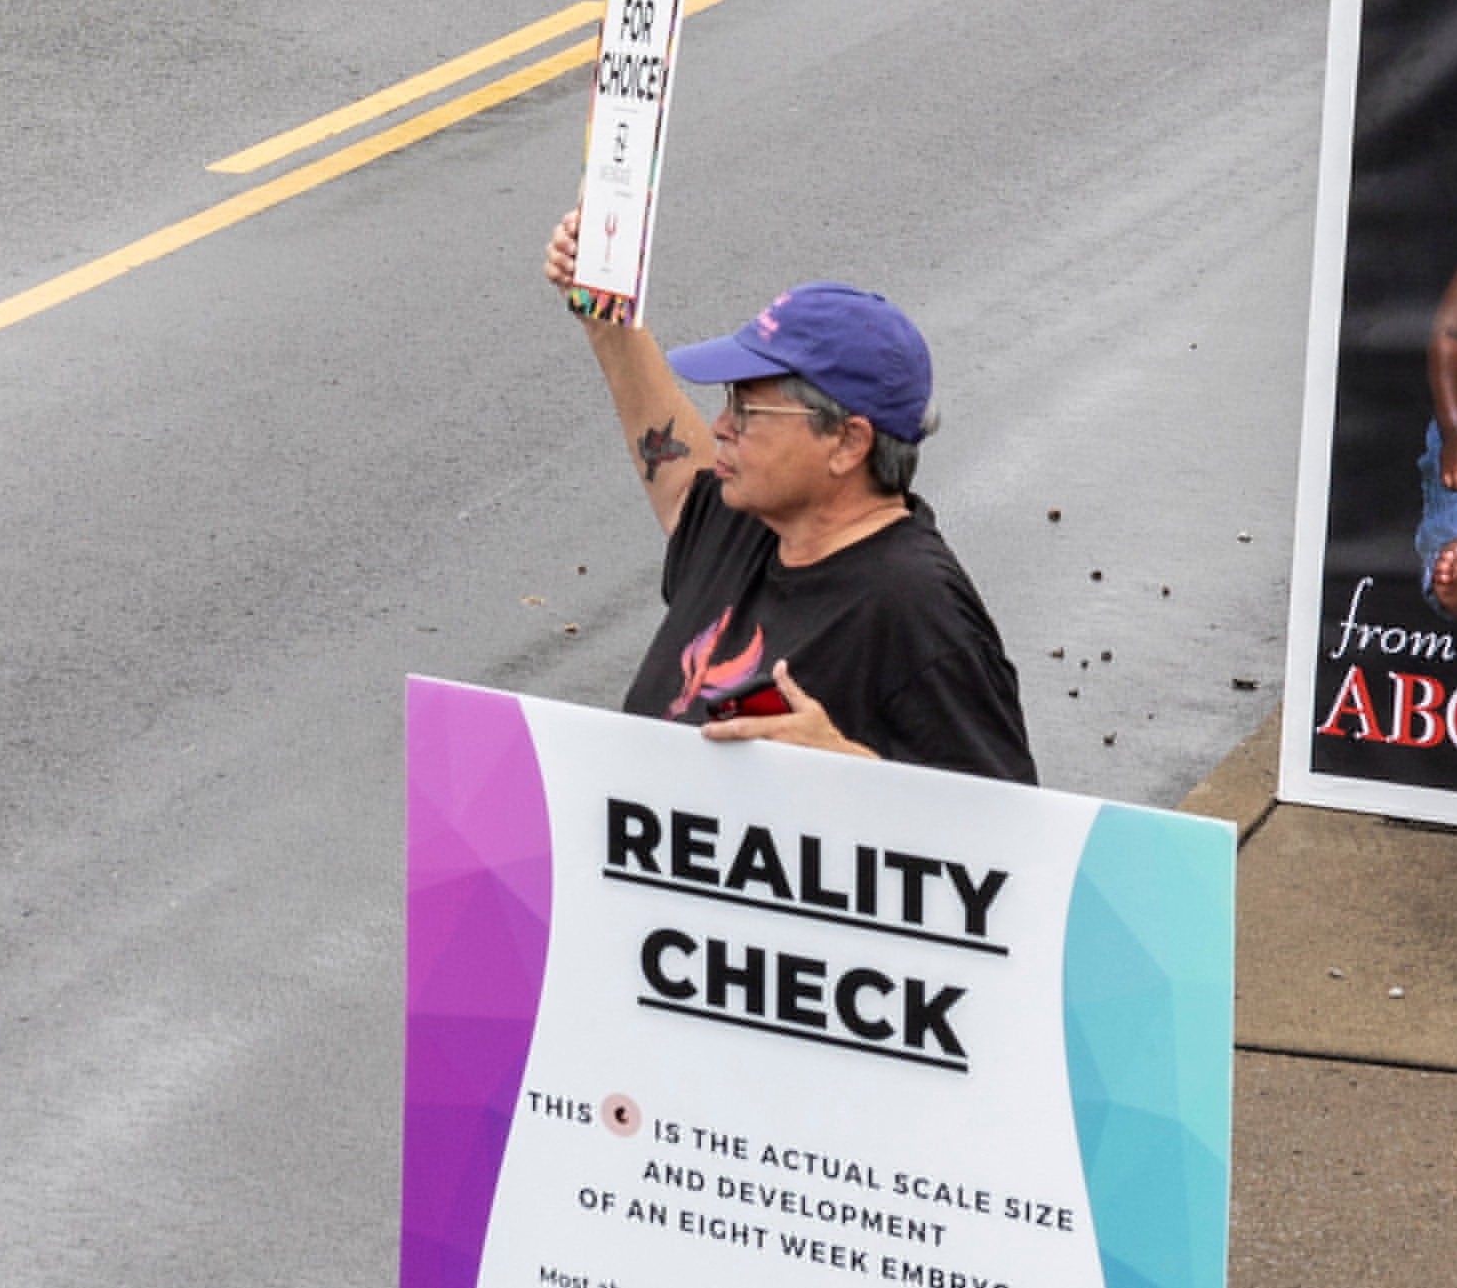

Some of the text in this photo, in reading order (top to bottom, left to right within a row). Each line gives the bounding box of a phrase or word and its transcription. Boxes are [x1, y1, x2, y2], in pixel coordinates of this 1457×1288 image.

[1328, 575, 1457, 661] from
[605, 796, 1010, 937] REALITY
[638, 927, 970, 1057] CHECK
[528, 1090, 1075, 1233] THIS IS THE ACTUAL SCALE SIZE
[642, 1159, 948, 1248] AND DEVELOPMENT
[577, 1186, 616, 1215] OF
[626, 1198, 668, 1228] AN
[678, 1209, 769, 1251] EIGHT
[780, 1232, 869, 1273] WEEK
